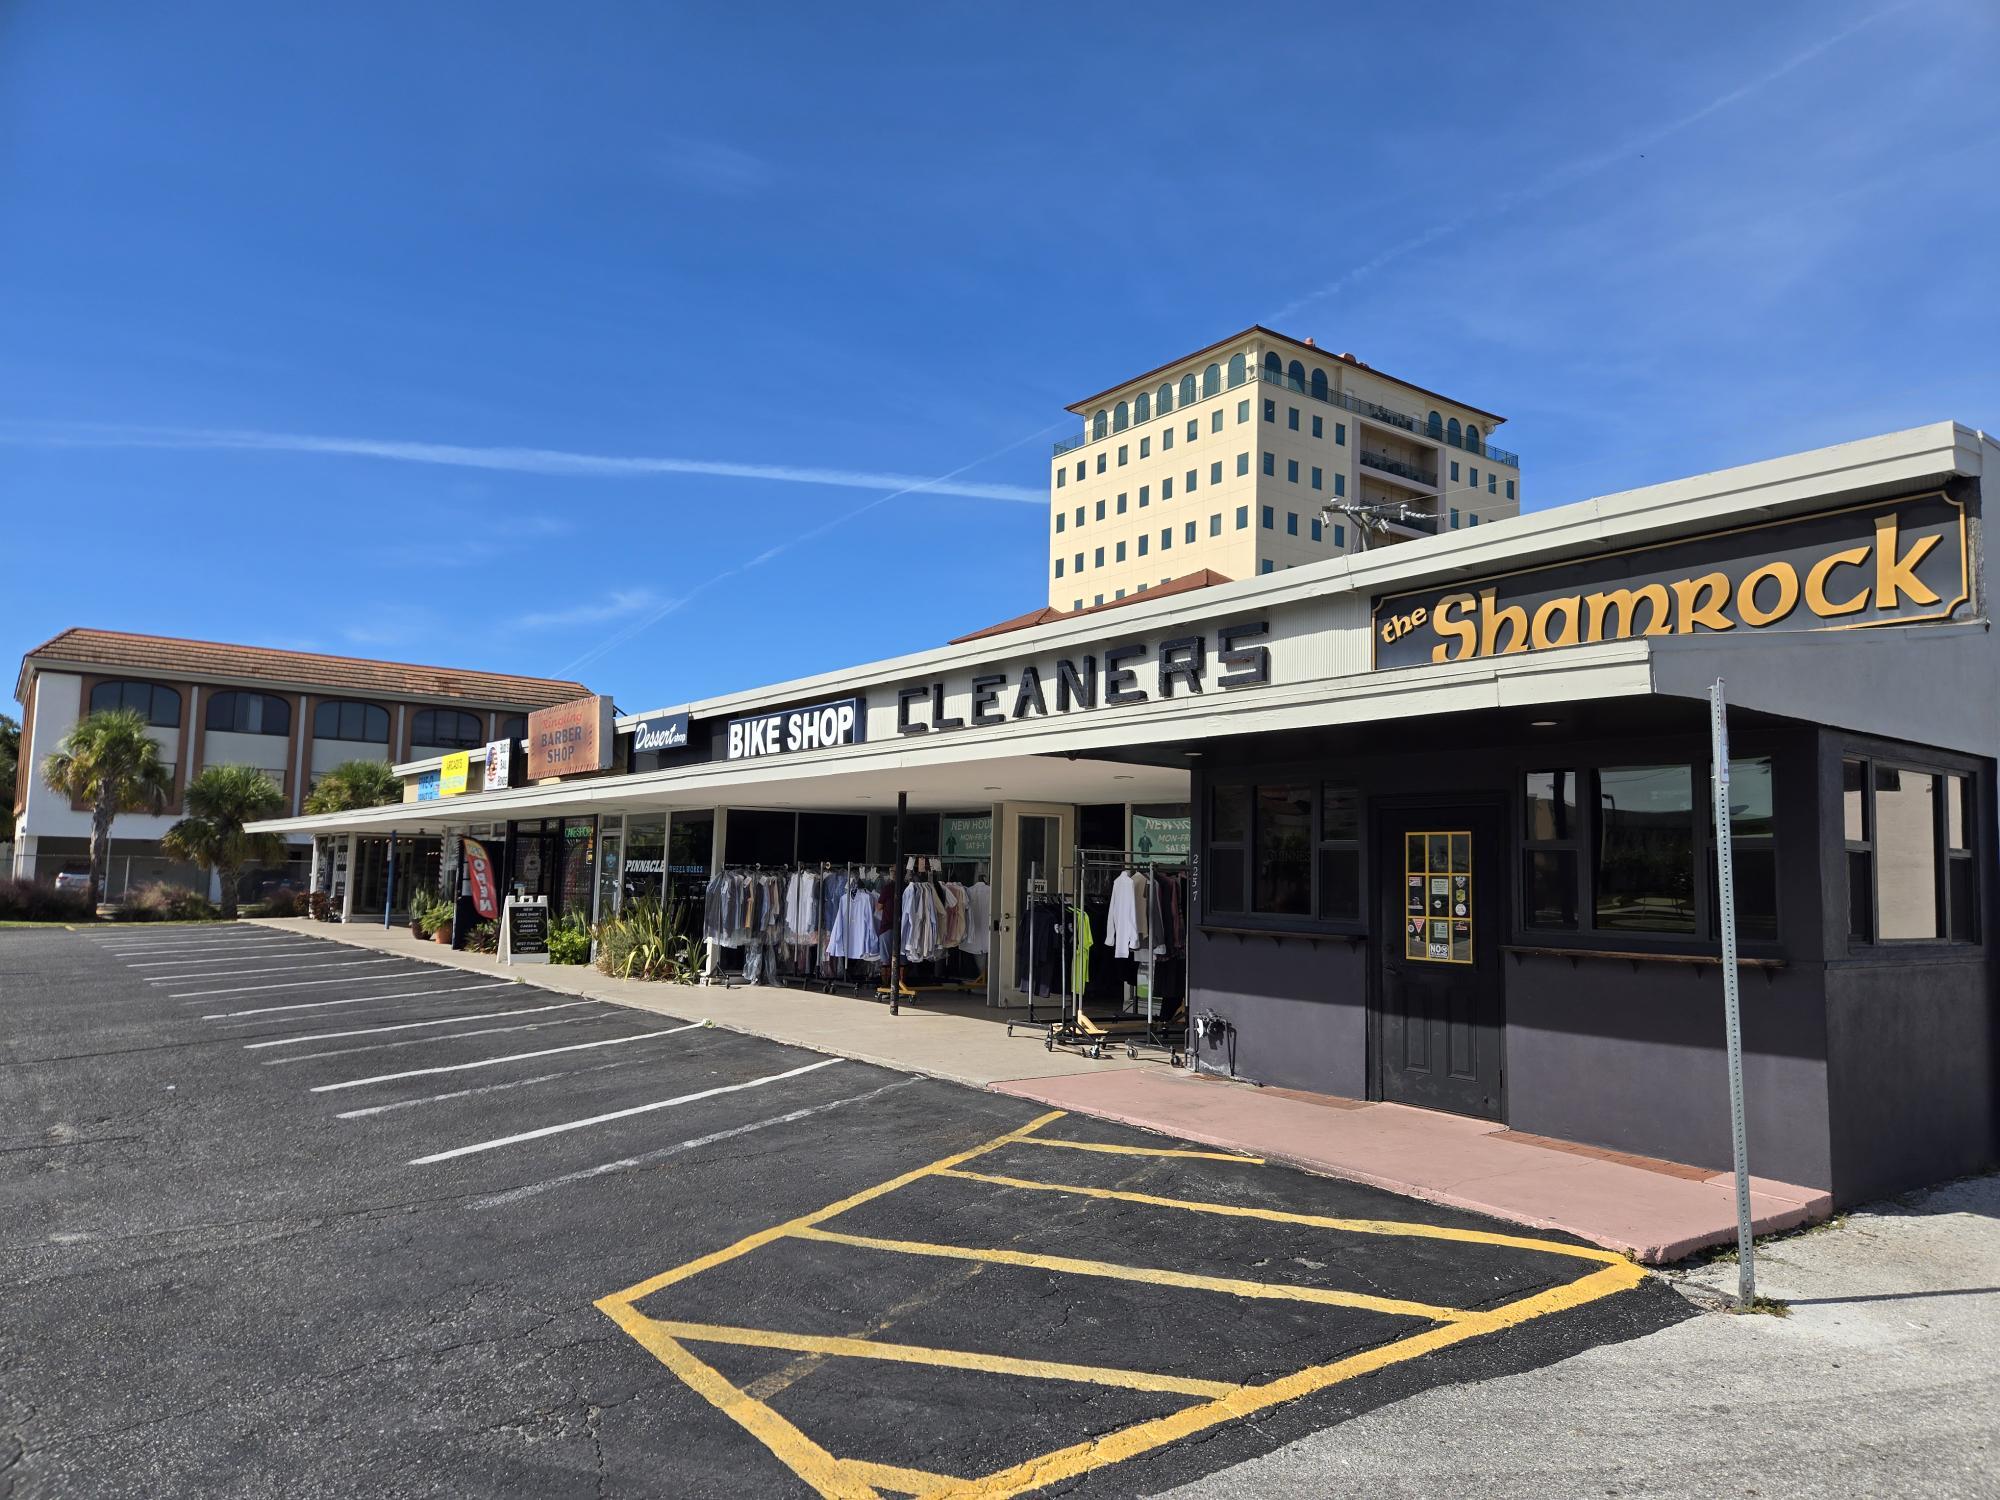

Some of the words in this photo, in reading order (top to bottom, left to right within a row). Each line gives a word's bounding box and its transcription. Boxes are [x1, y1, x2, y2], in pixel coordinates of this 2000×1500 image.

[1381, 607, 1428, 644] the
[897, 621, 1270, 734] CLEANERS
[541, 725, 582, 748] BARBER
[635, 722, 677, 750] Dessert
[674, 733, 686, 744] shop
[729, 716, 781, 759] BIKE
[786, 705, 854, 751] SHOP
[547, 744, 575, 764] SHOP
[952, 821, 971, 831] NEW
[1165, 844, 1179, 852] SAT
[625, 859, 665, 873] PINNACLE
[474, 859, 493, 912] OPEN
